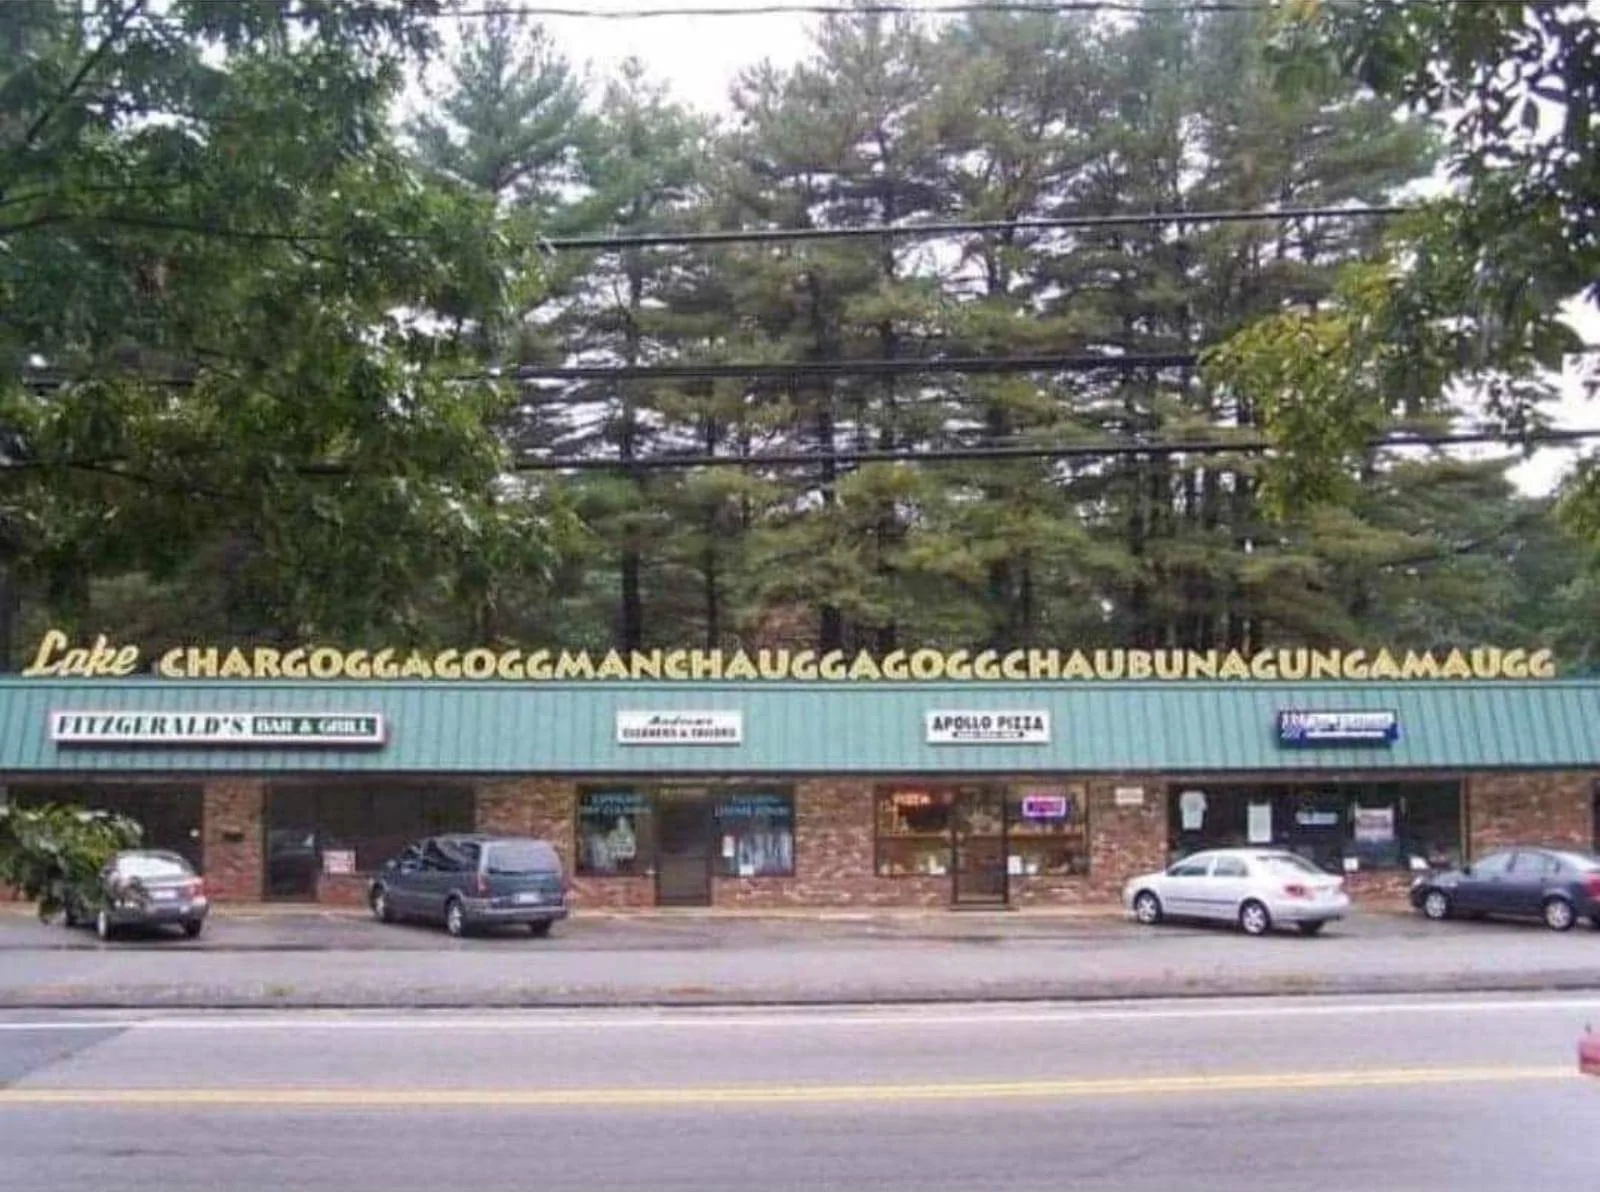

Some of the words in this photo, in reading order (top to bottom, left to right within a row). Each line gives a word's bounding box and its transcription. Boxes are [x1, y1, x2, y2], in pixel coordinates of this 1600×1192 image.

[22, 629, 139, 677] Lake
[159, 647, 1555, 680] CHARGOGGAGOGGMANCHAUGGAGOGGCHAUBUNAGUNGAMAUGG
[58, 714, 246, 735] FITZGERALD'S
[256, 718, 293, 733] BAR
[299, 718, 311, 733] &
[318, 718, 369, 733] GRILL
[933, 715, 992, 731] APOLLO
[997, 715, 1044, 731] PIZZA
